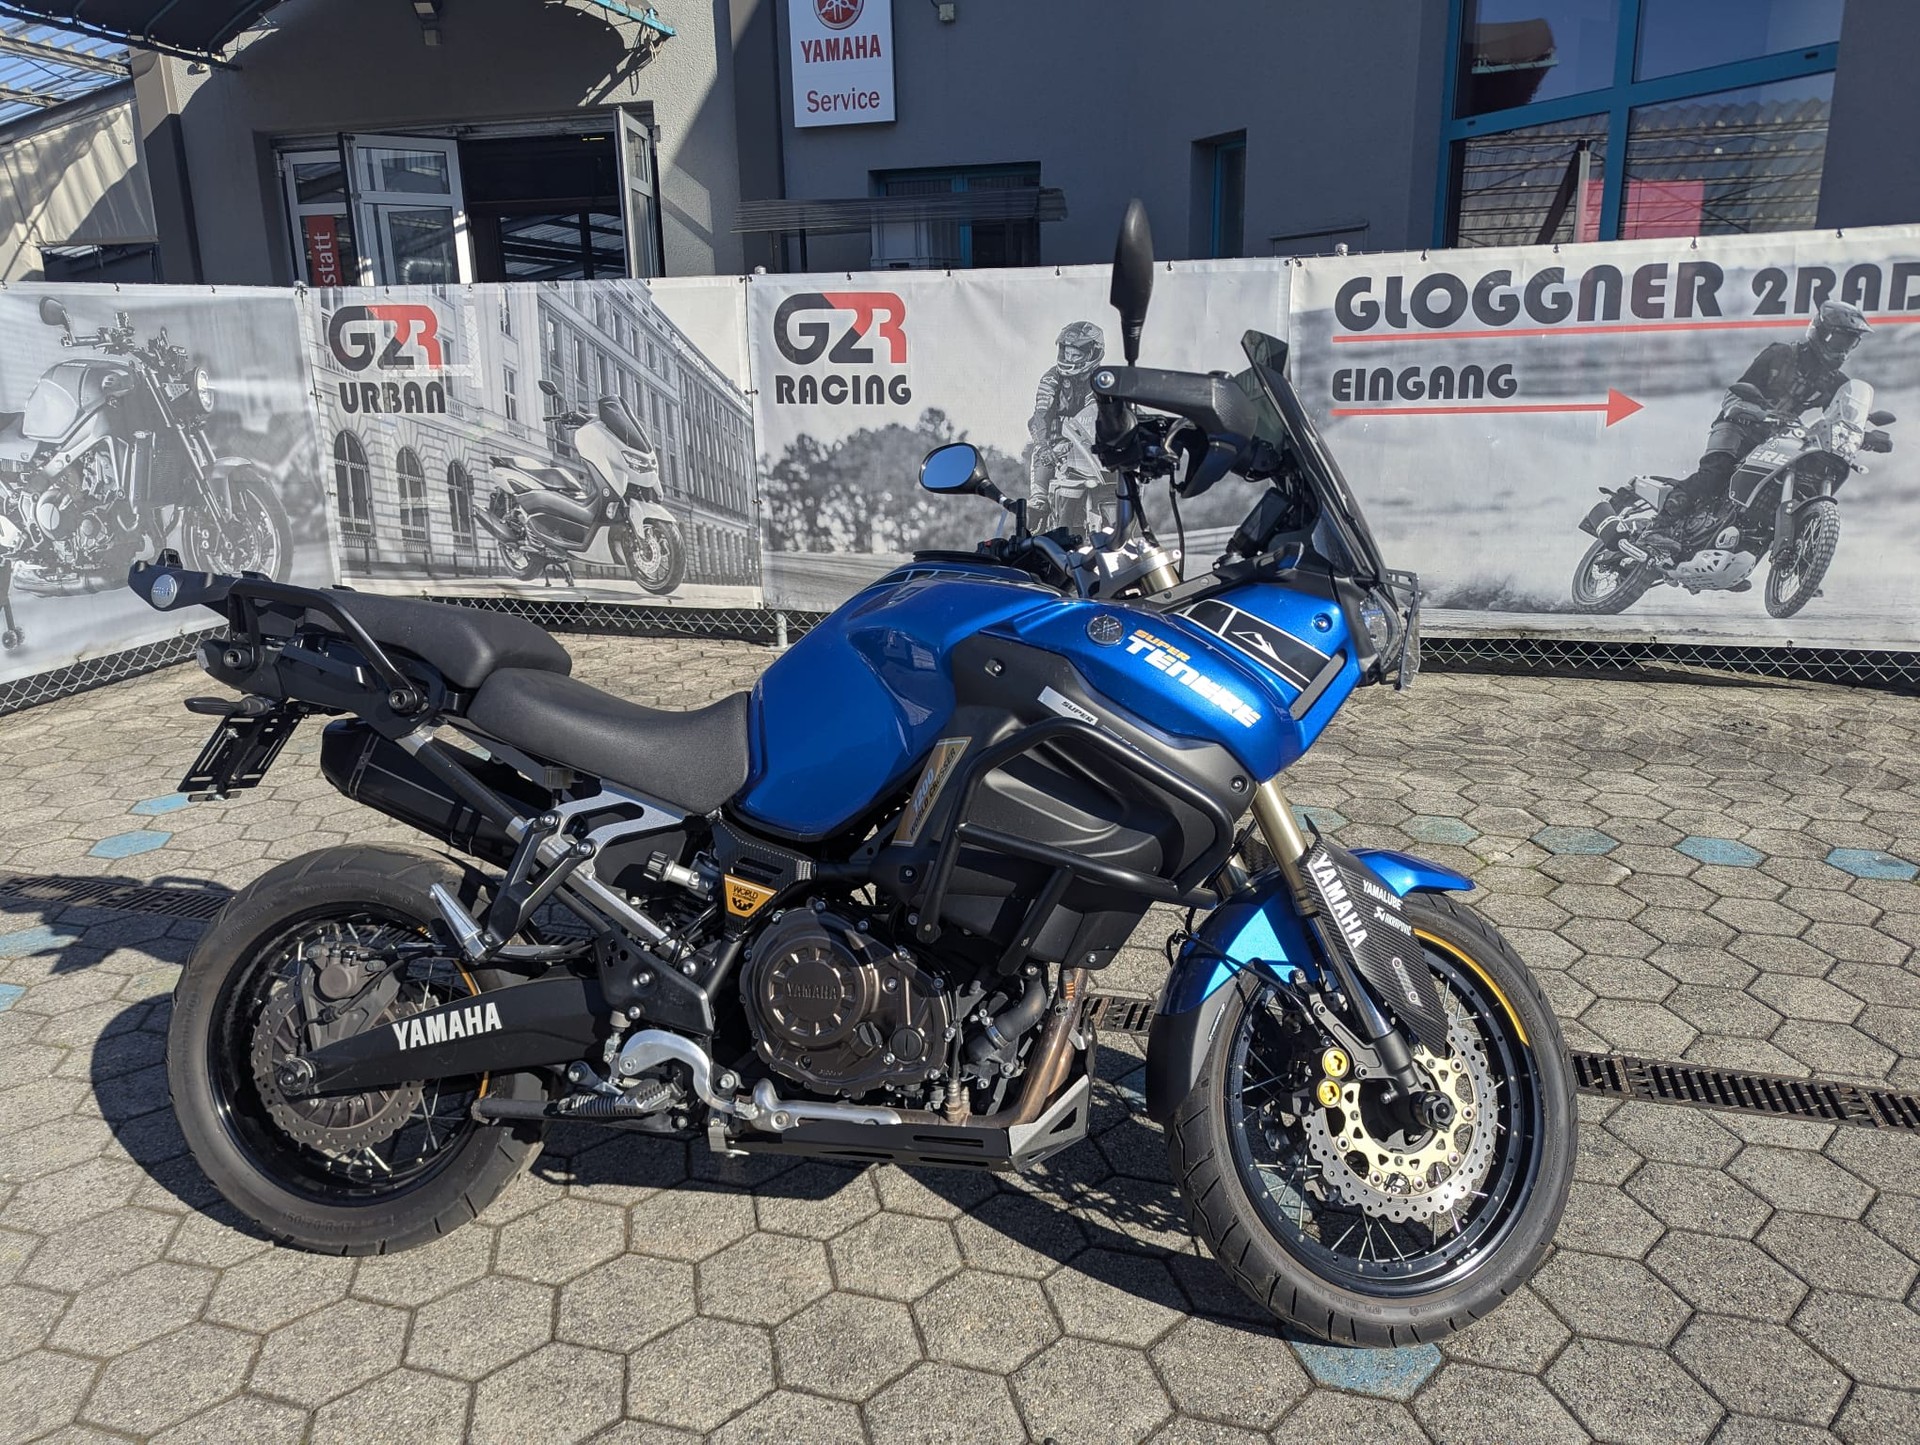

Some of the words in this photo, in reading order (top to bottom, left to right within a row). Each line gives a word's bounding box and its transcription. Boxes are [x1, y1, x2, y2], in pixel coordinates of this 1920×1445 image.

[800, 34, 882, 64] YAMAHA
[807, 87, 880, 113] Service
[313, 231, 337, 288] statt
[1335, 261, 1724, 332] GLOGGNER
[338, 381, 446, 414] URBAN
[775, 374, 912, 405] RACING
[1332, 363, 1518, 402] EINGANG
[1134, 629, 1191, 662] SUPER
[1061, 701, 1095, 723] SUPER
[1312, 852, 1369, 949] YAMAHA
[1362, 879, 1404, 912] YAMALUBE
[785, 982, 838, 1000] YAMAHA
[391, 1002, 503, 1051] YAMAHA
